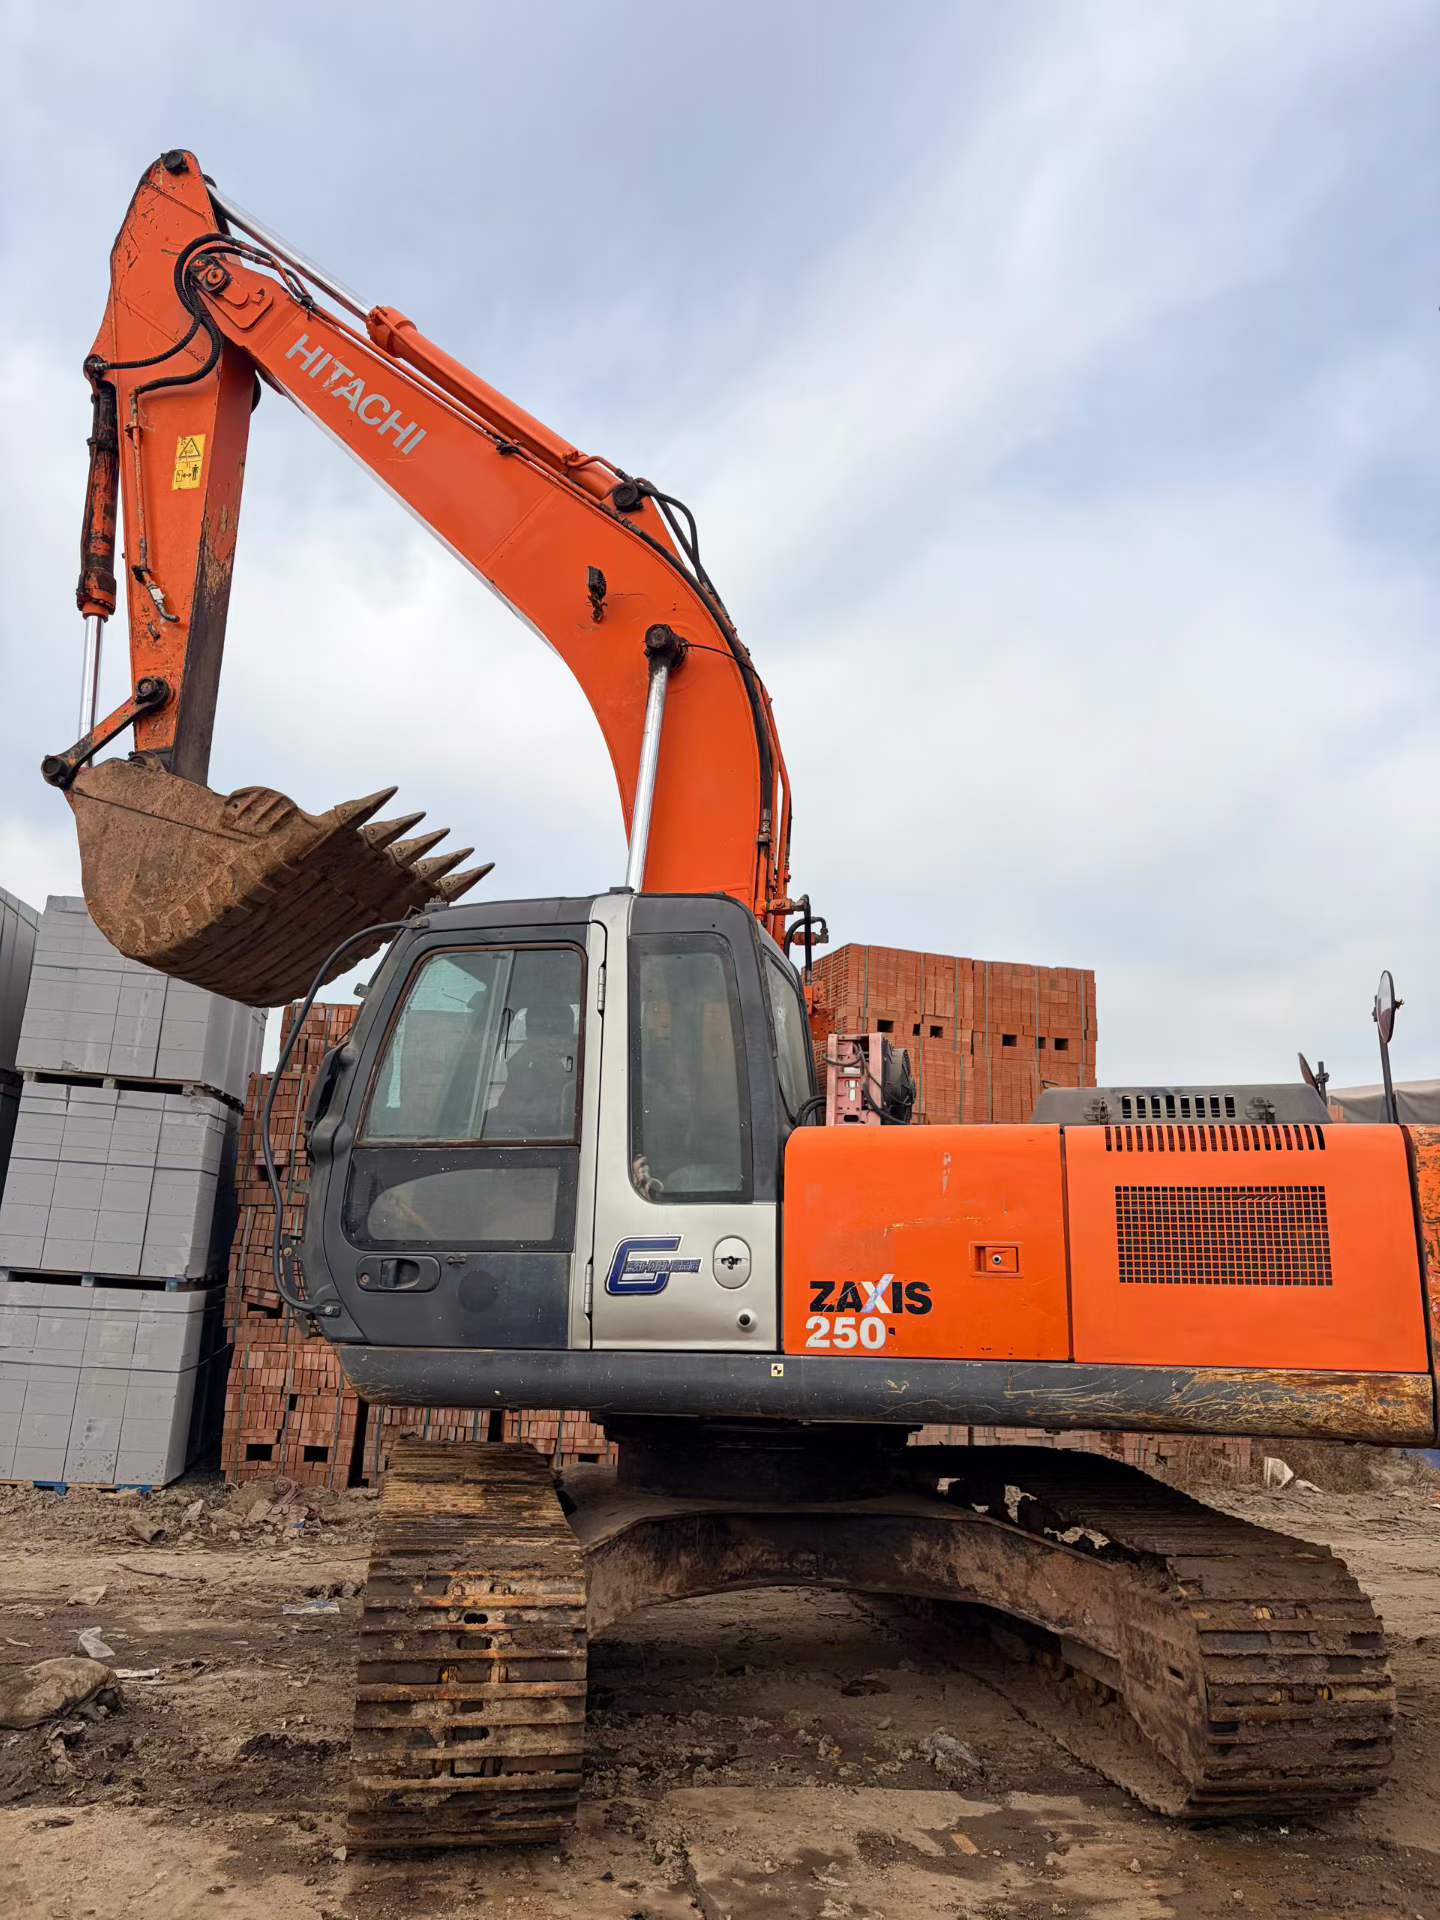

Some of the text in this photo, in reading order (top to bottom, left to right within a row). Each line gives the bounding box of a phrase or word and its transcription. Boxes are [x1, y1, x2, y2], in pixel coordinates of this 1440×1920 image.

[285, 333, 428, 455] HITACHI
[809, 1273, 933, 1315] ZAXIS
[805, 1316, 886, 1349] 250
